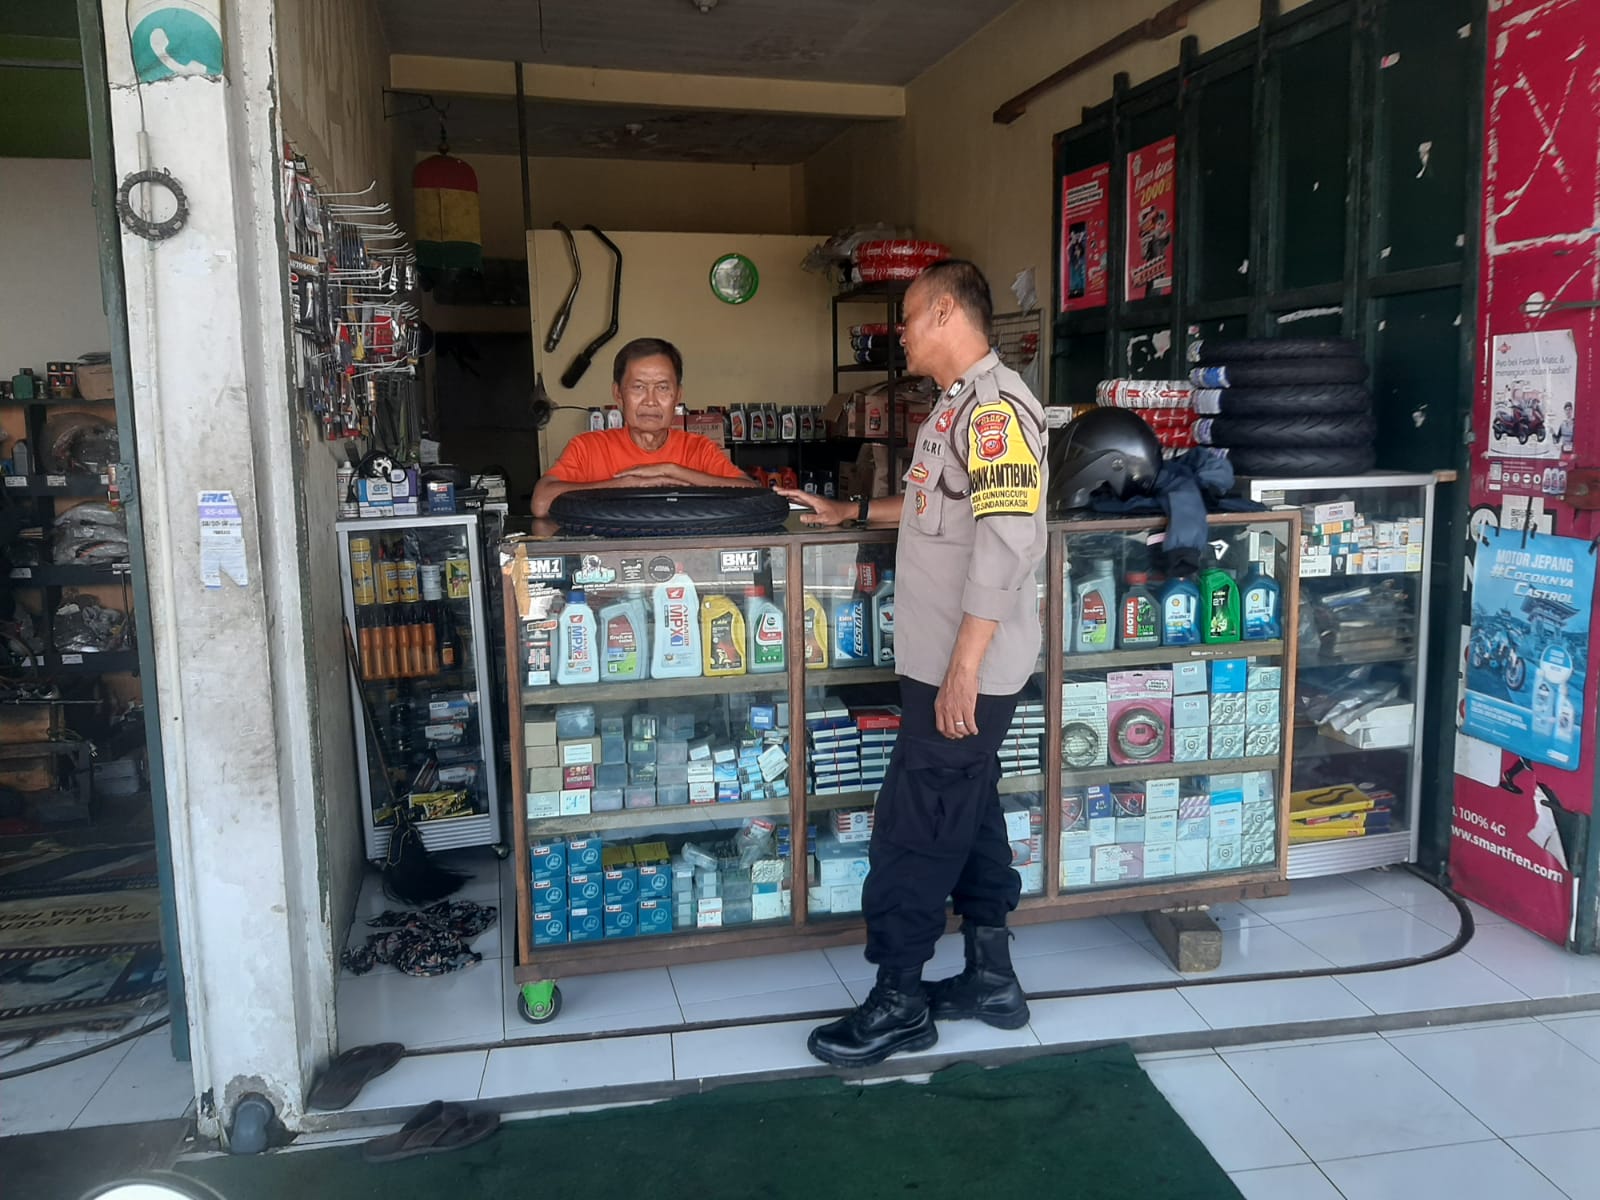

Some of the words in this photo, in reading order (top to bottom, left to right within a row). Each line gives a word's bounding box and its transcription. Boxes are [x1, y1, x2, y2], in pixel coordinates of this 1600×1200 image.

[722, 552, 758, 566] BM1
[1496, 549, 1531, 568] MOTOR
[1532, 554, 1574, 574] JEPANG
[1213, 598, 1225, 606] 2T
[1126, 601, 1135, 635] MOTUL
[1459, 807, 1489, 829] 100%
[1490, 821, 1506, 838] 4G
